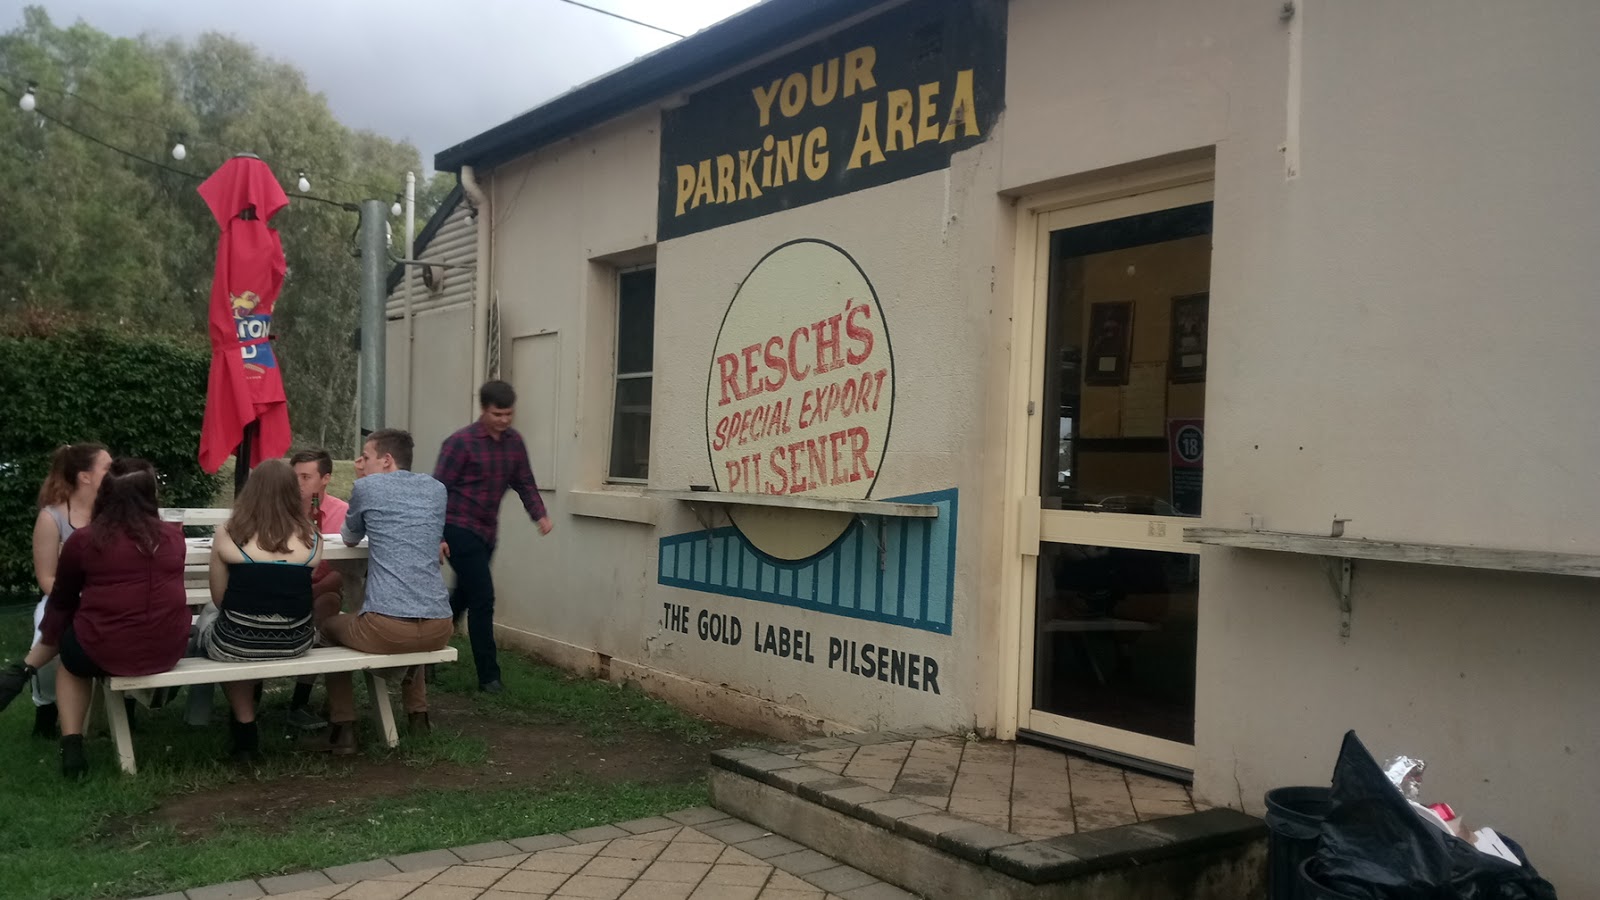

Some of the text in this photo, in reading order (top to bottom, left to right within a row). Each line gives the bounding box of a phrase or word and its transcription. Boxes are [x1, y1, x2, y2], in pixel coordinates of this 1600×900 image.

[752, 46, 877, 127] YOUR
[846, 69, 980, 170] AREA
[237, 320, 270, 338] TON
[717, 298, 874, 406] RESCH'S
[713, 368, 887, 451] SPECIAL EXPORT
[1182, 438, 1198, 456] 18
[725, 426, 875, 495] PILSENER
[663, 602, 941, 695] THE GOLD LABEL PILSENER
